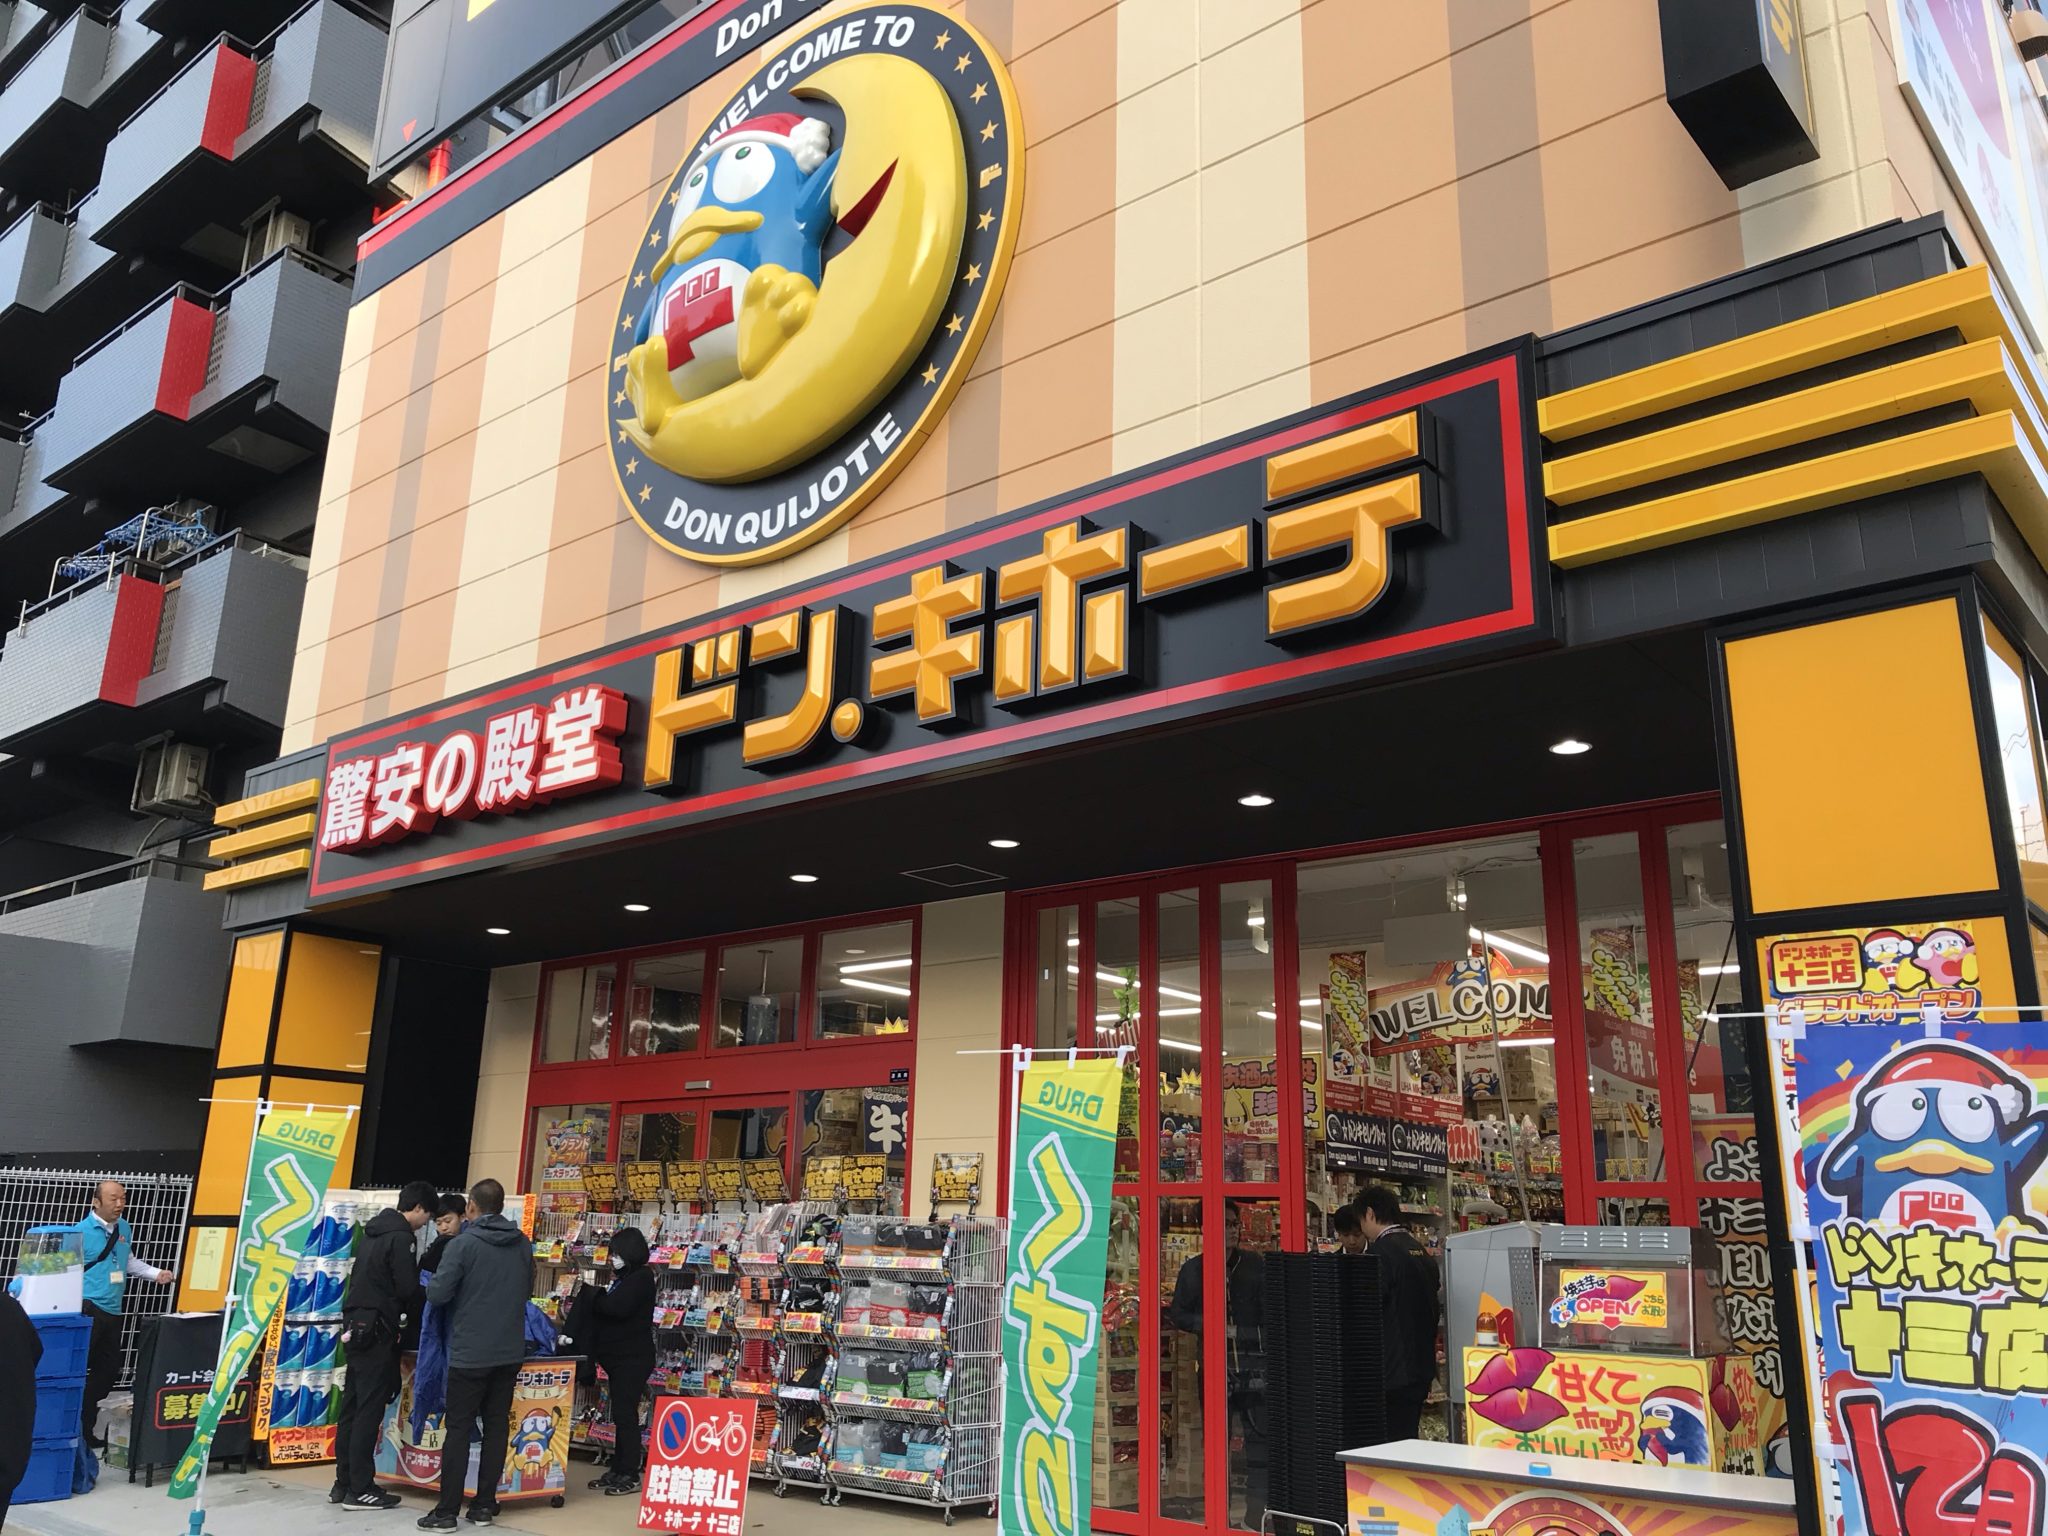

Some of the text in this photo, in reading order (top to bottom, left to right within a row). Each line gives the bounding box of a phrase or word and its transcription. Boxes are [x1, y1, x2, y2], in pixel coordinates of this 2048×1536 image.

[715, 0, 783, 58] Don
[872, 15, 915, 47] TO
[664, 413, 903, 545] DON QUIJOTE
[320, 687, 606, 850] 驚安の殿堂
[1779, 959, 1858, 988] 十三店
[1369, 979, 1553, 1043] WELCOM
[1563, 1274, 1607, 1298] 焼き芋は
[1576, 1298, 1642, 1316] OPEN!
[1838, 1288, 2048, 1391] 十三店
[165, 1369, 249, 1384] カード会
[1551, 1363, 1642, 1405] 甘くて
[1514, 1431, 1600, 1460] おいしい
[646, 1463, 740, 1510] 駐輪禁止
[638, 1506, 741, 1535] ドン・キホーテ 十三店
